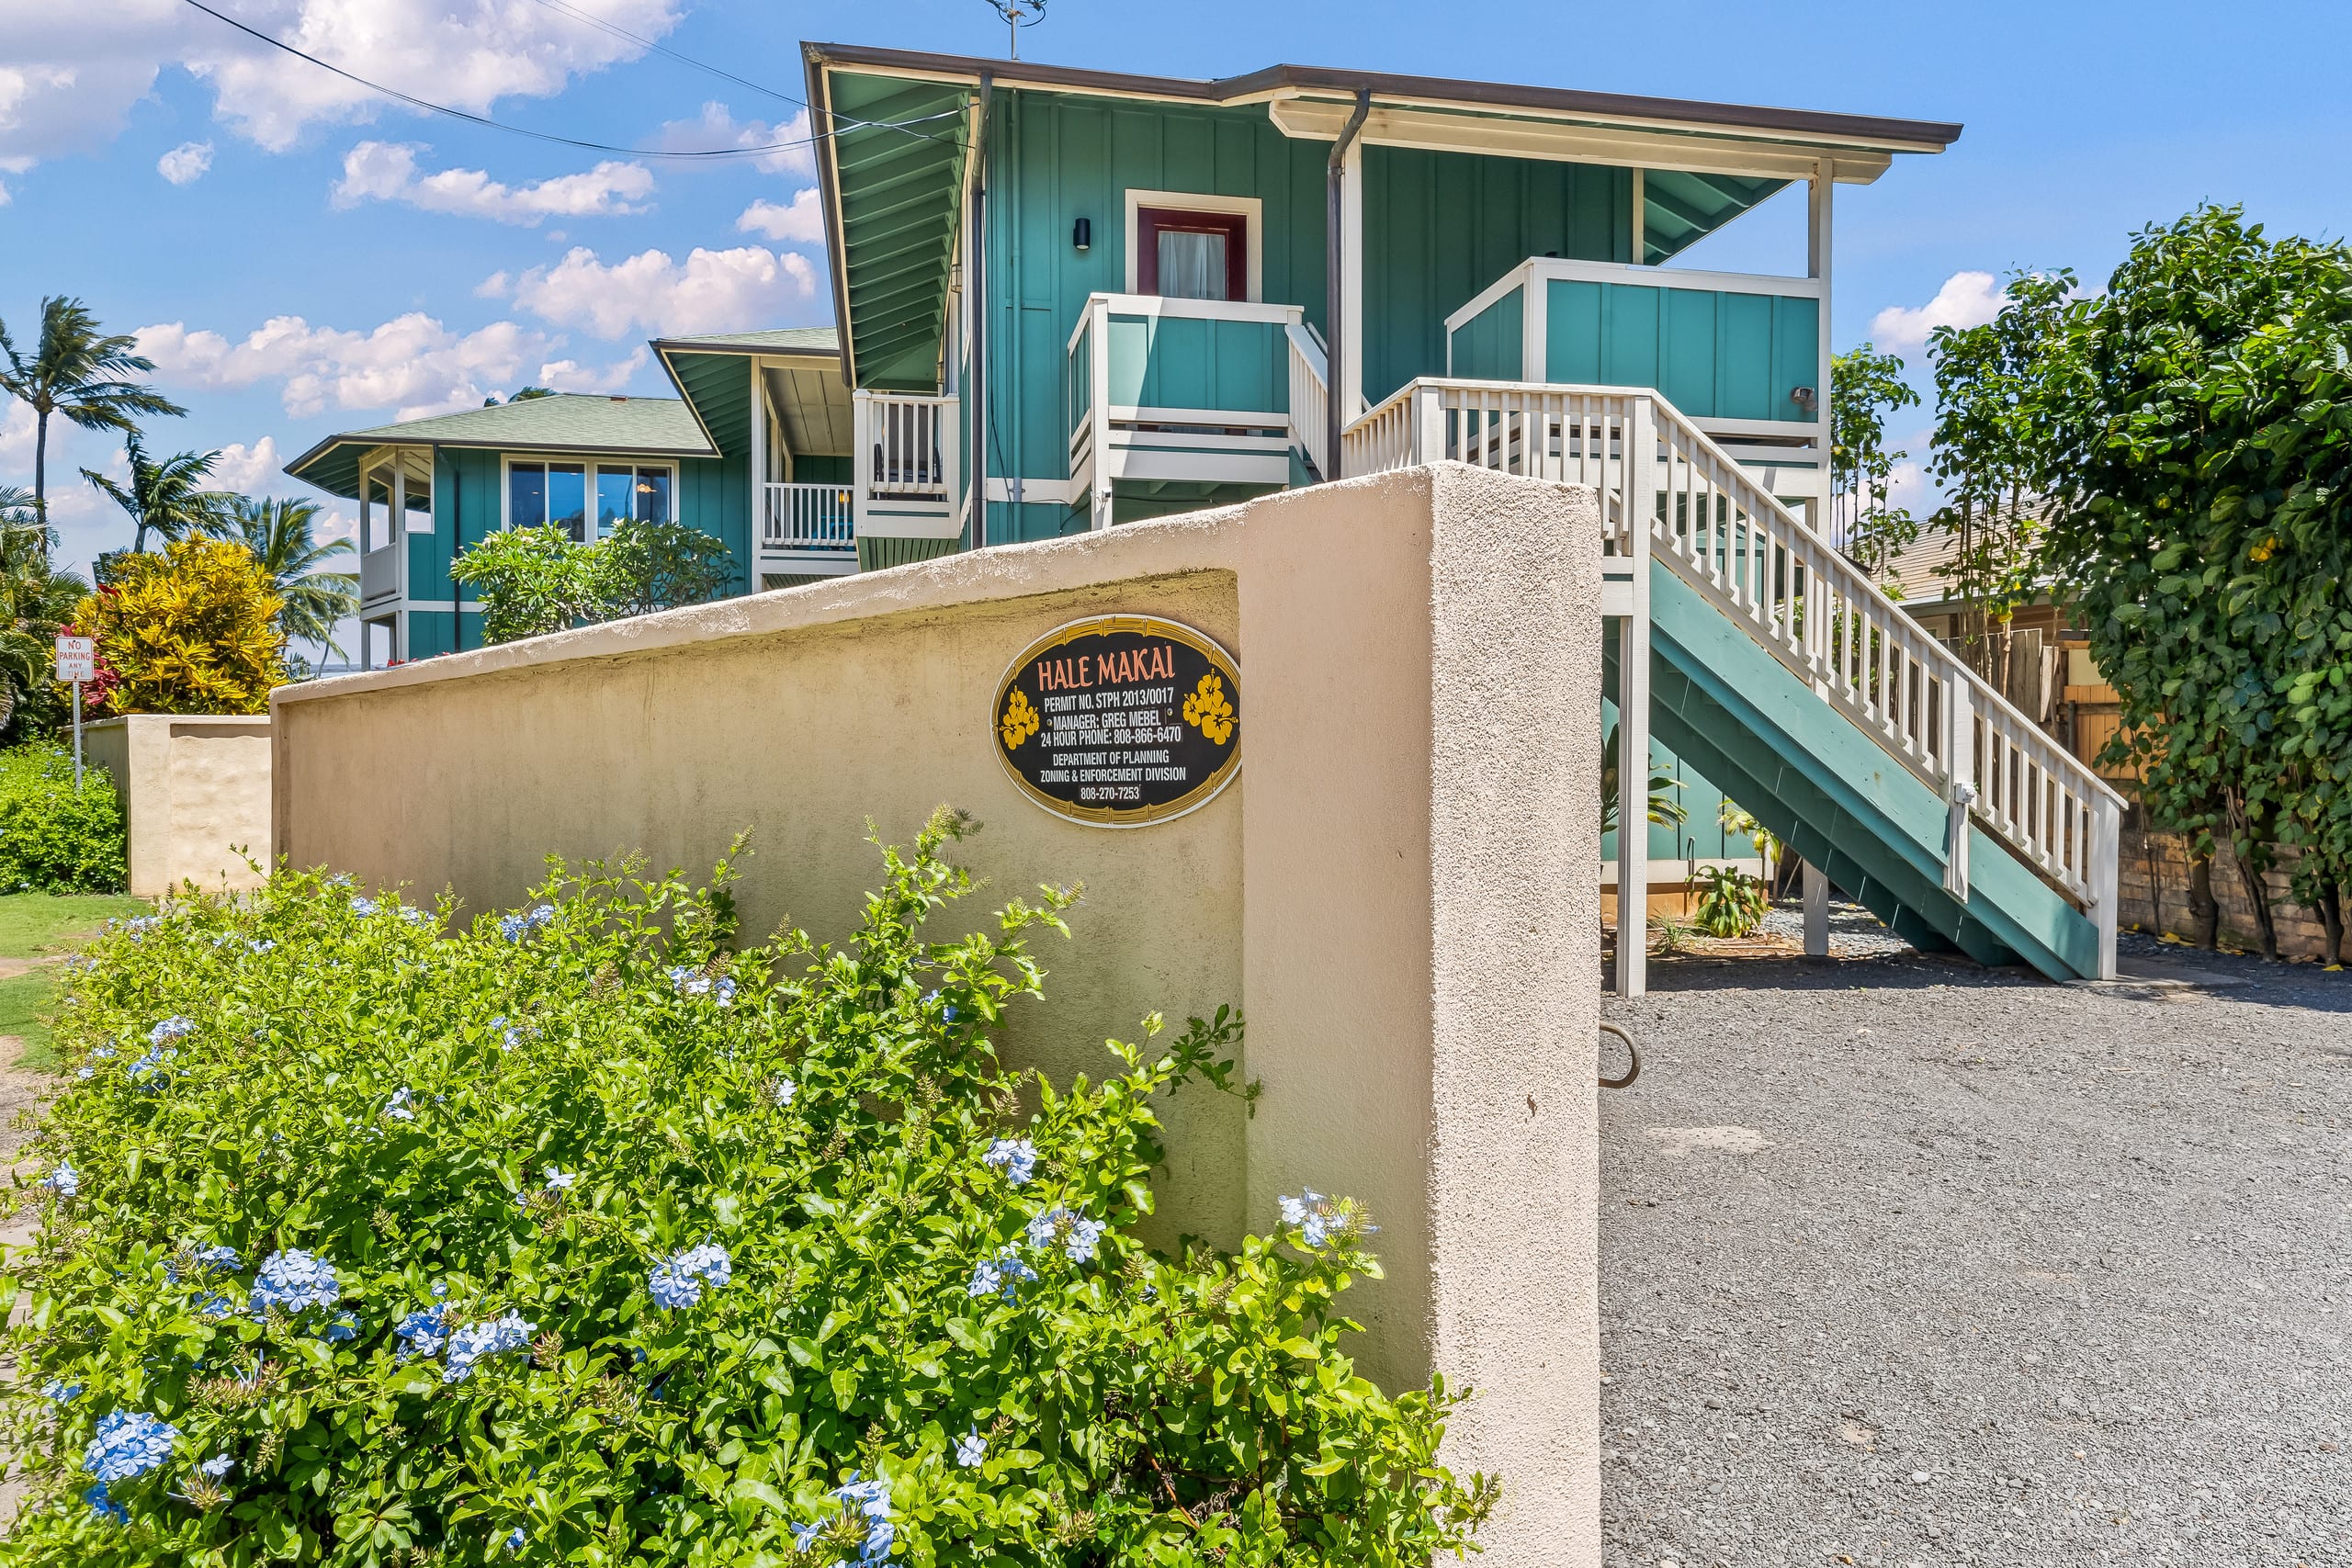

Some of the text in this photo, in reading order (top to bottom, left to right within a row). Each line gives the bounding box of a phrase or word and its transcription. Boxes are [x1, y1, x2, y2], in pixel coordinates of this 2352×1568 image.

[68, 641, 81, 649] NO
[60, 652, 90, 660] PARKING
[1037, 646, 1175, 691] HALE MAKAI
[1045, 687, 1174, 713] PERMIT NO. STPH 2013/0017
[1054, 709, 1161, 731] MANAGER: GREG MEBEL
[1041, 726, 1182, 747] 24 HOUR PHONE: 808-866-6470
[1053, 750, 1169, 766] DEPARTMENT OF PLANNING
[1040, 767, 1186, 783] ZONING & ENFORCEMENT DIVISION
[1080, 786, 1139, 800] 808-270-7253
